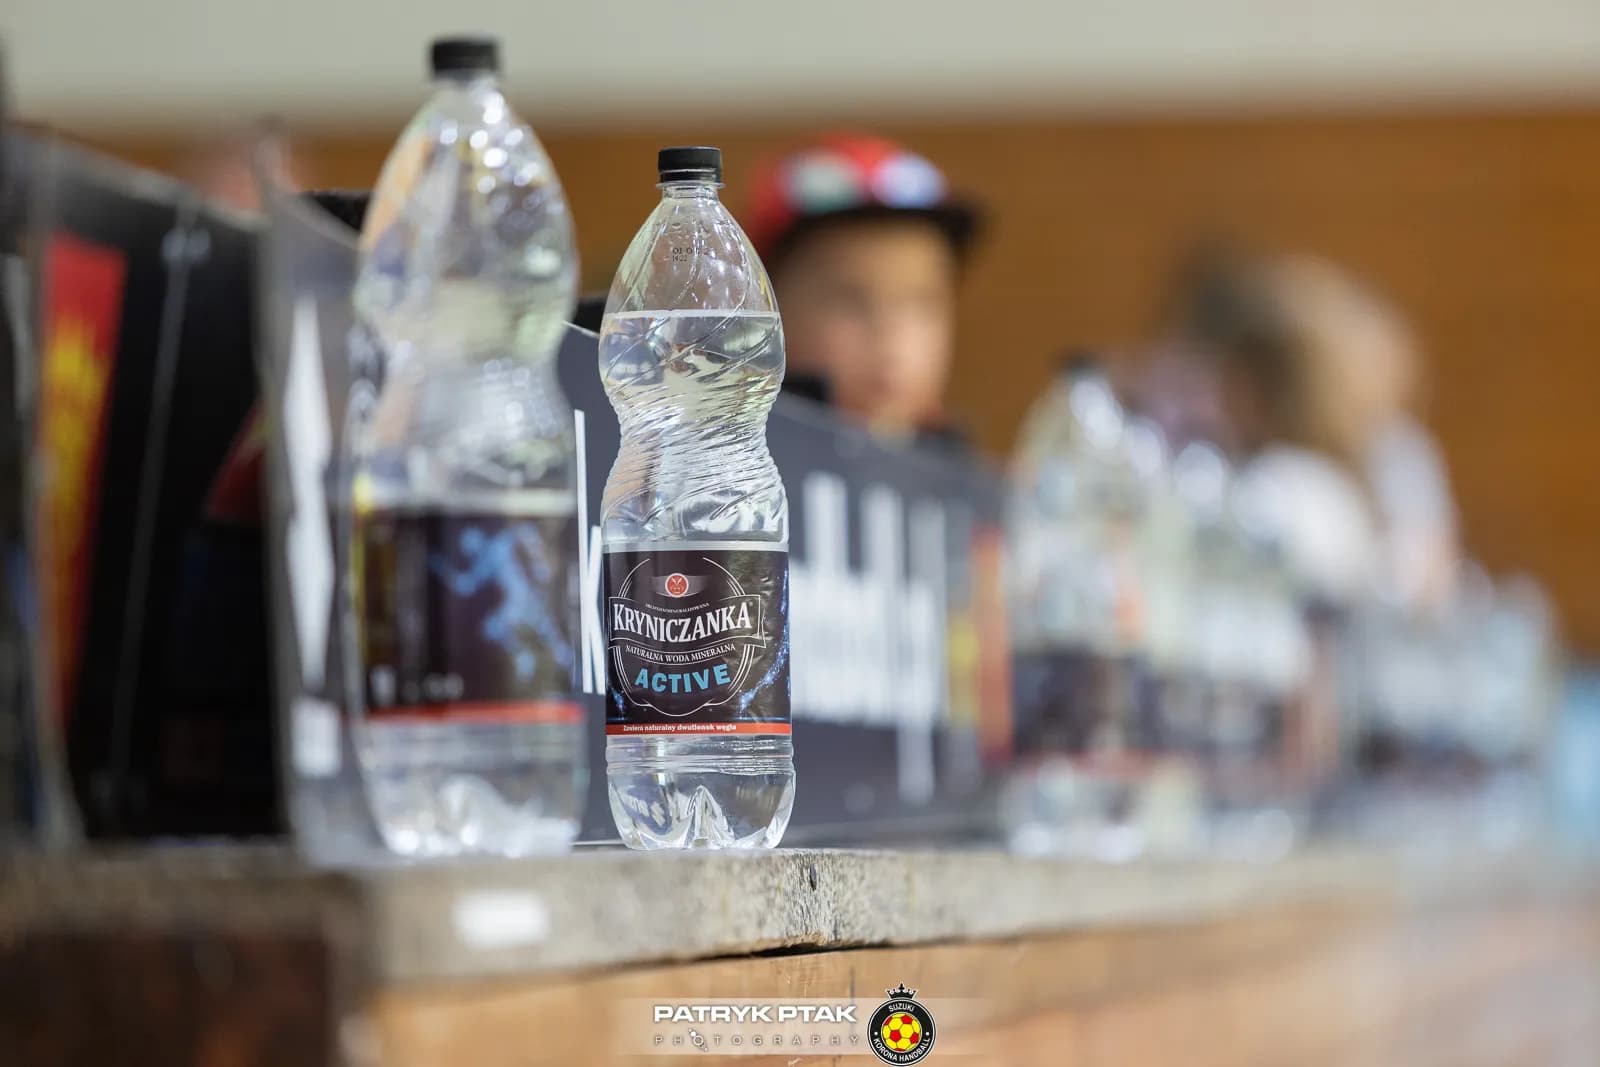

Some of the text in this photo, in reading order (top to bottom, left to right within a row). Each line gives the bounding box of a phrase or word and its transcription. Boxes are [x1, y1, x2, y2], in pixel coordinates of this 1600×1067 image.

[613, 602, 753, 643] KRYNICZANKA
[625, 643, 736, 663] NATURALNA WODA MINERALNA
[634, 664, 731, 694] ACTIVE
[644, 724, 676, 732] naturalny
